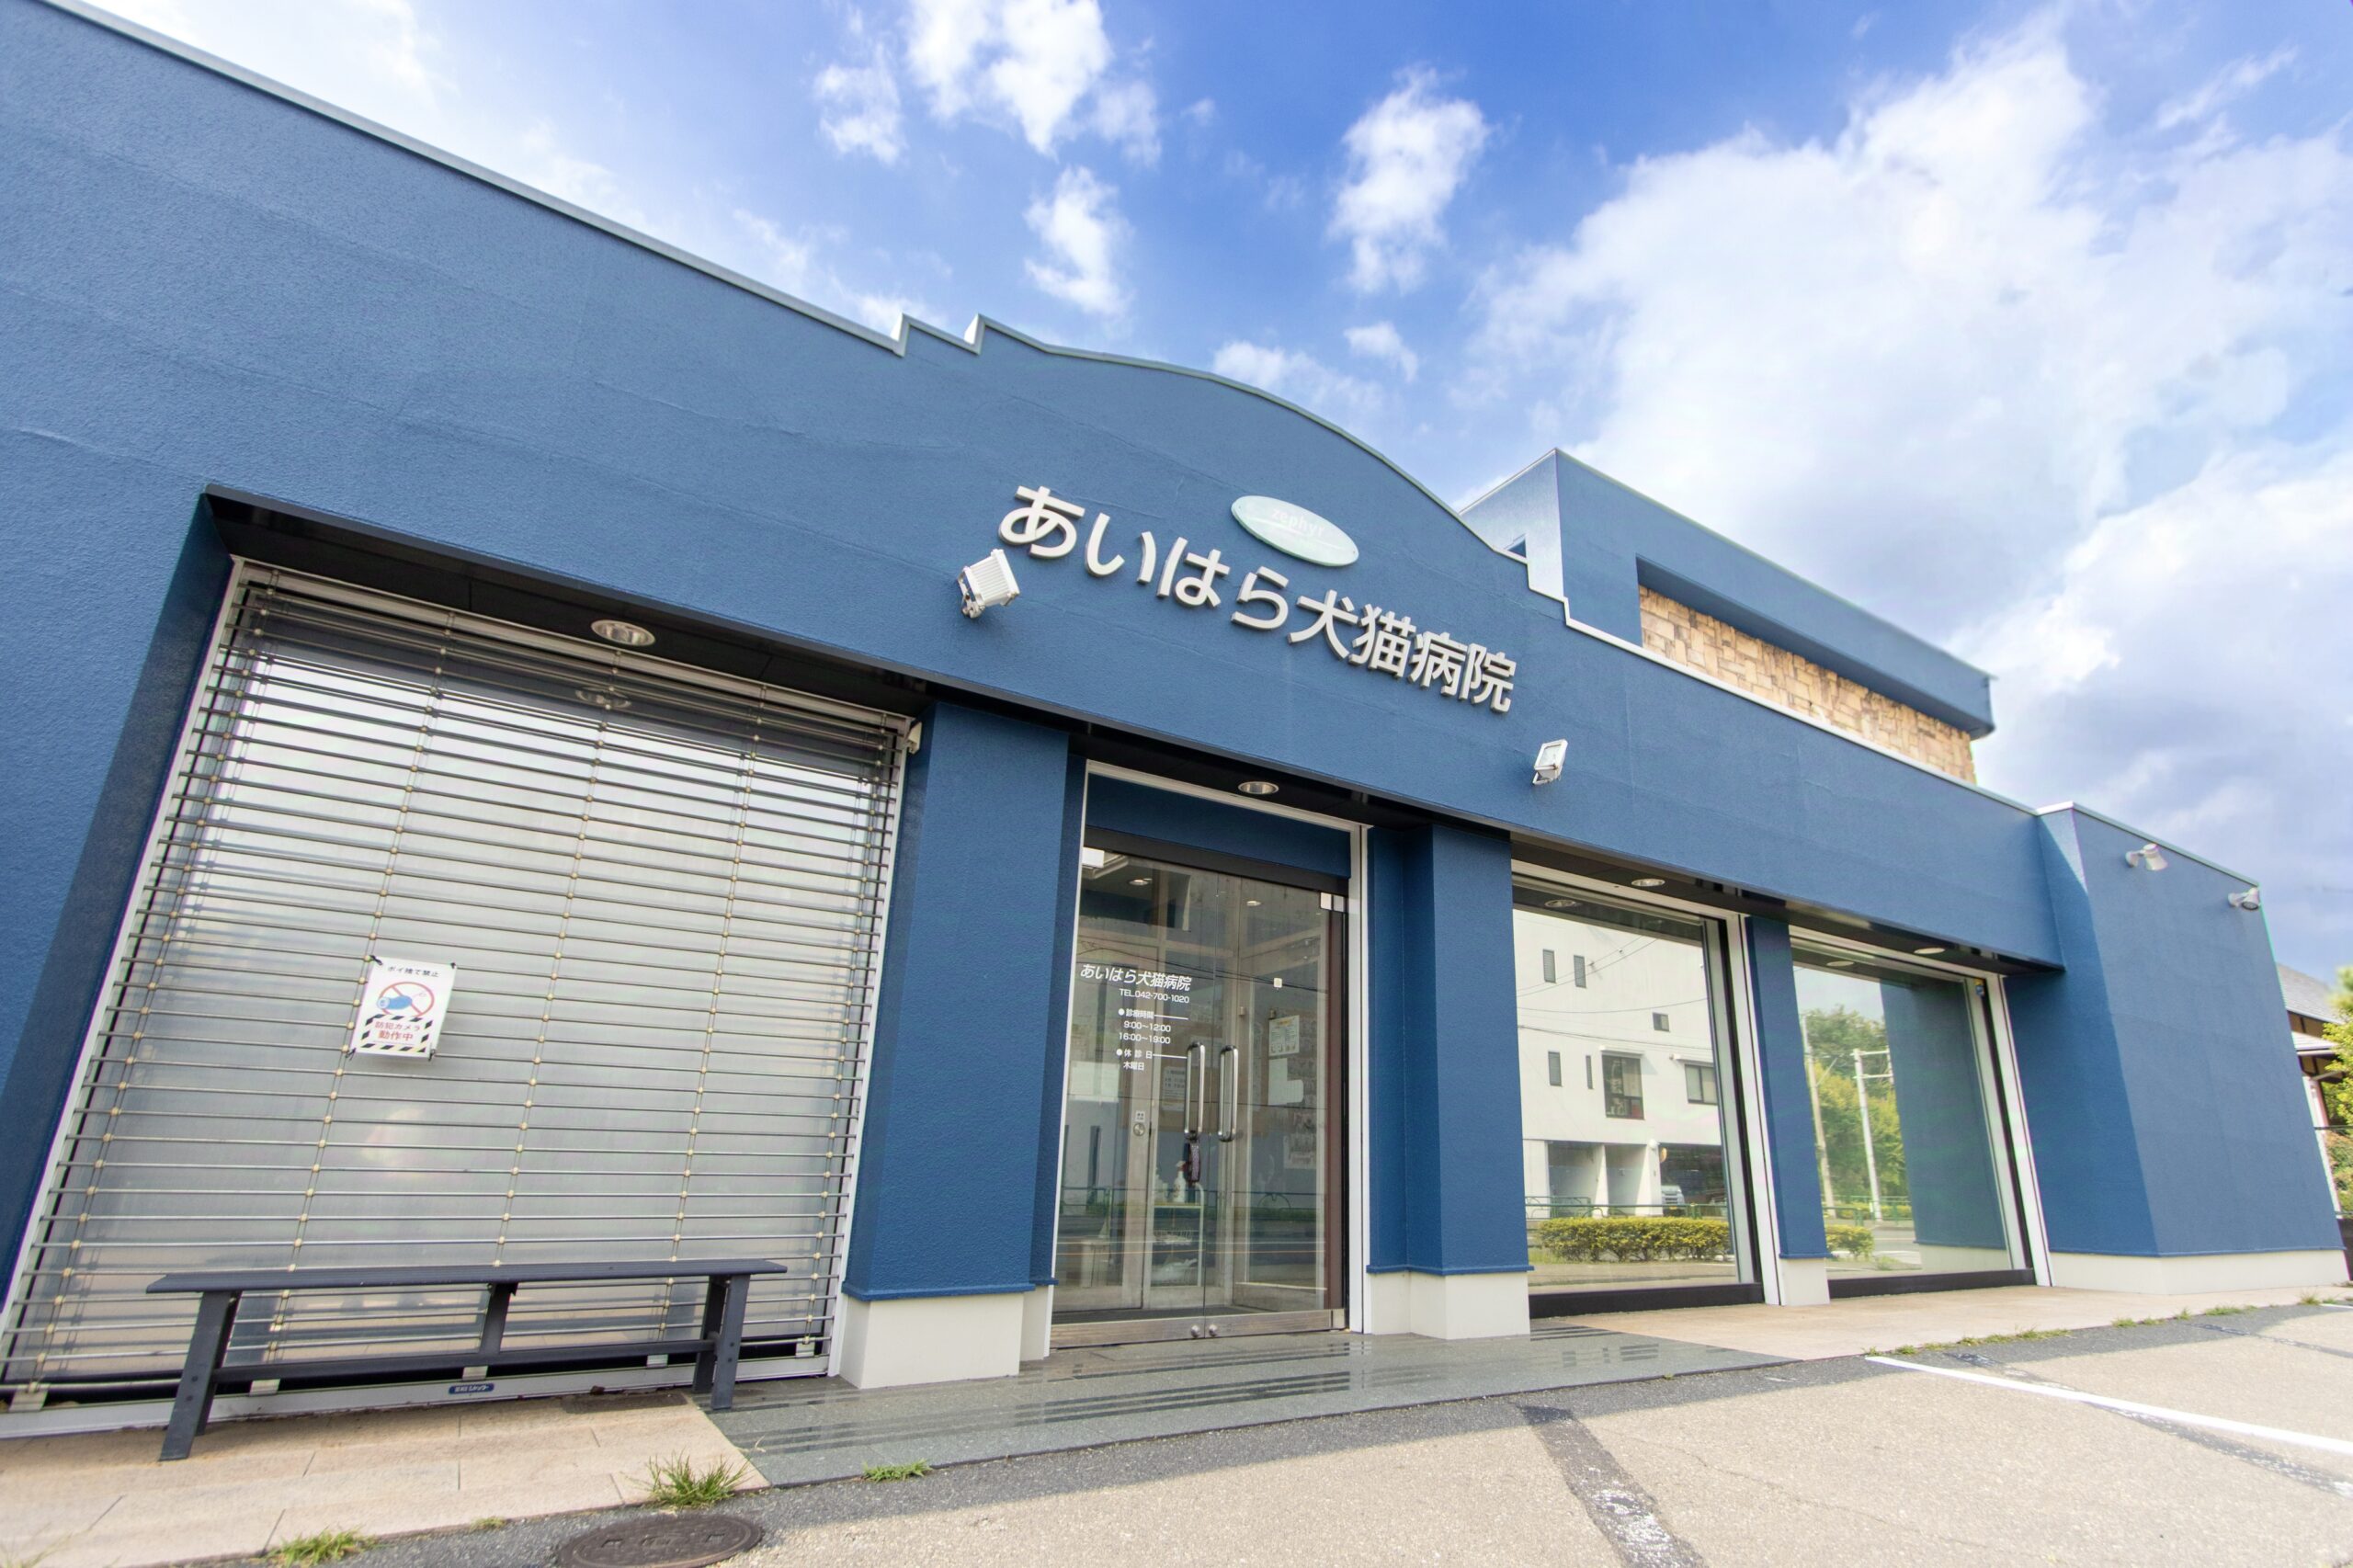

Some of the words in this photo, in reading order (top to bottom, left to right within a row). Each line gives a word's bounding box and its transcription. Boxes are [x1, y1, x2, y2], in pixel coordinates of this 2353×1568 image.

[1270, 507, 1325, 539] zephyr
[998, 485, 1517, 714] あいはら犬猫病院
[387, 965, 441, 978] ポイ捨て禁止
[1080, 963, 1193, 992] あいはら犬猫病院
[1125, 1008, 1154, 1019] 診療時間
[374, 1021, 421, 1031] 防犯カメラ
[378, 1030, 414, 1041] 動作中
